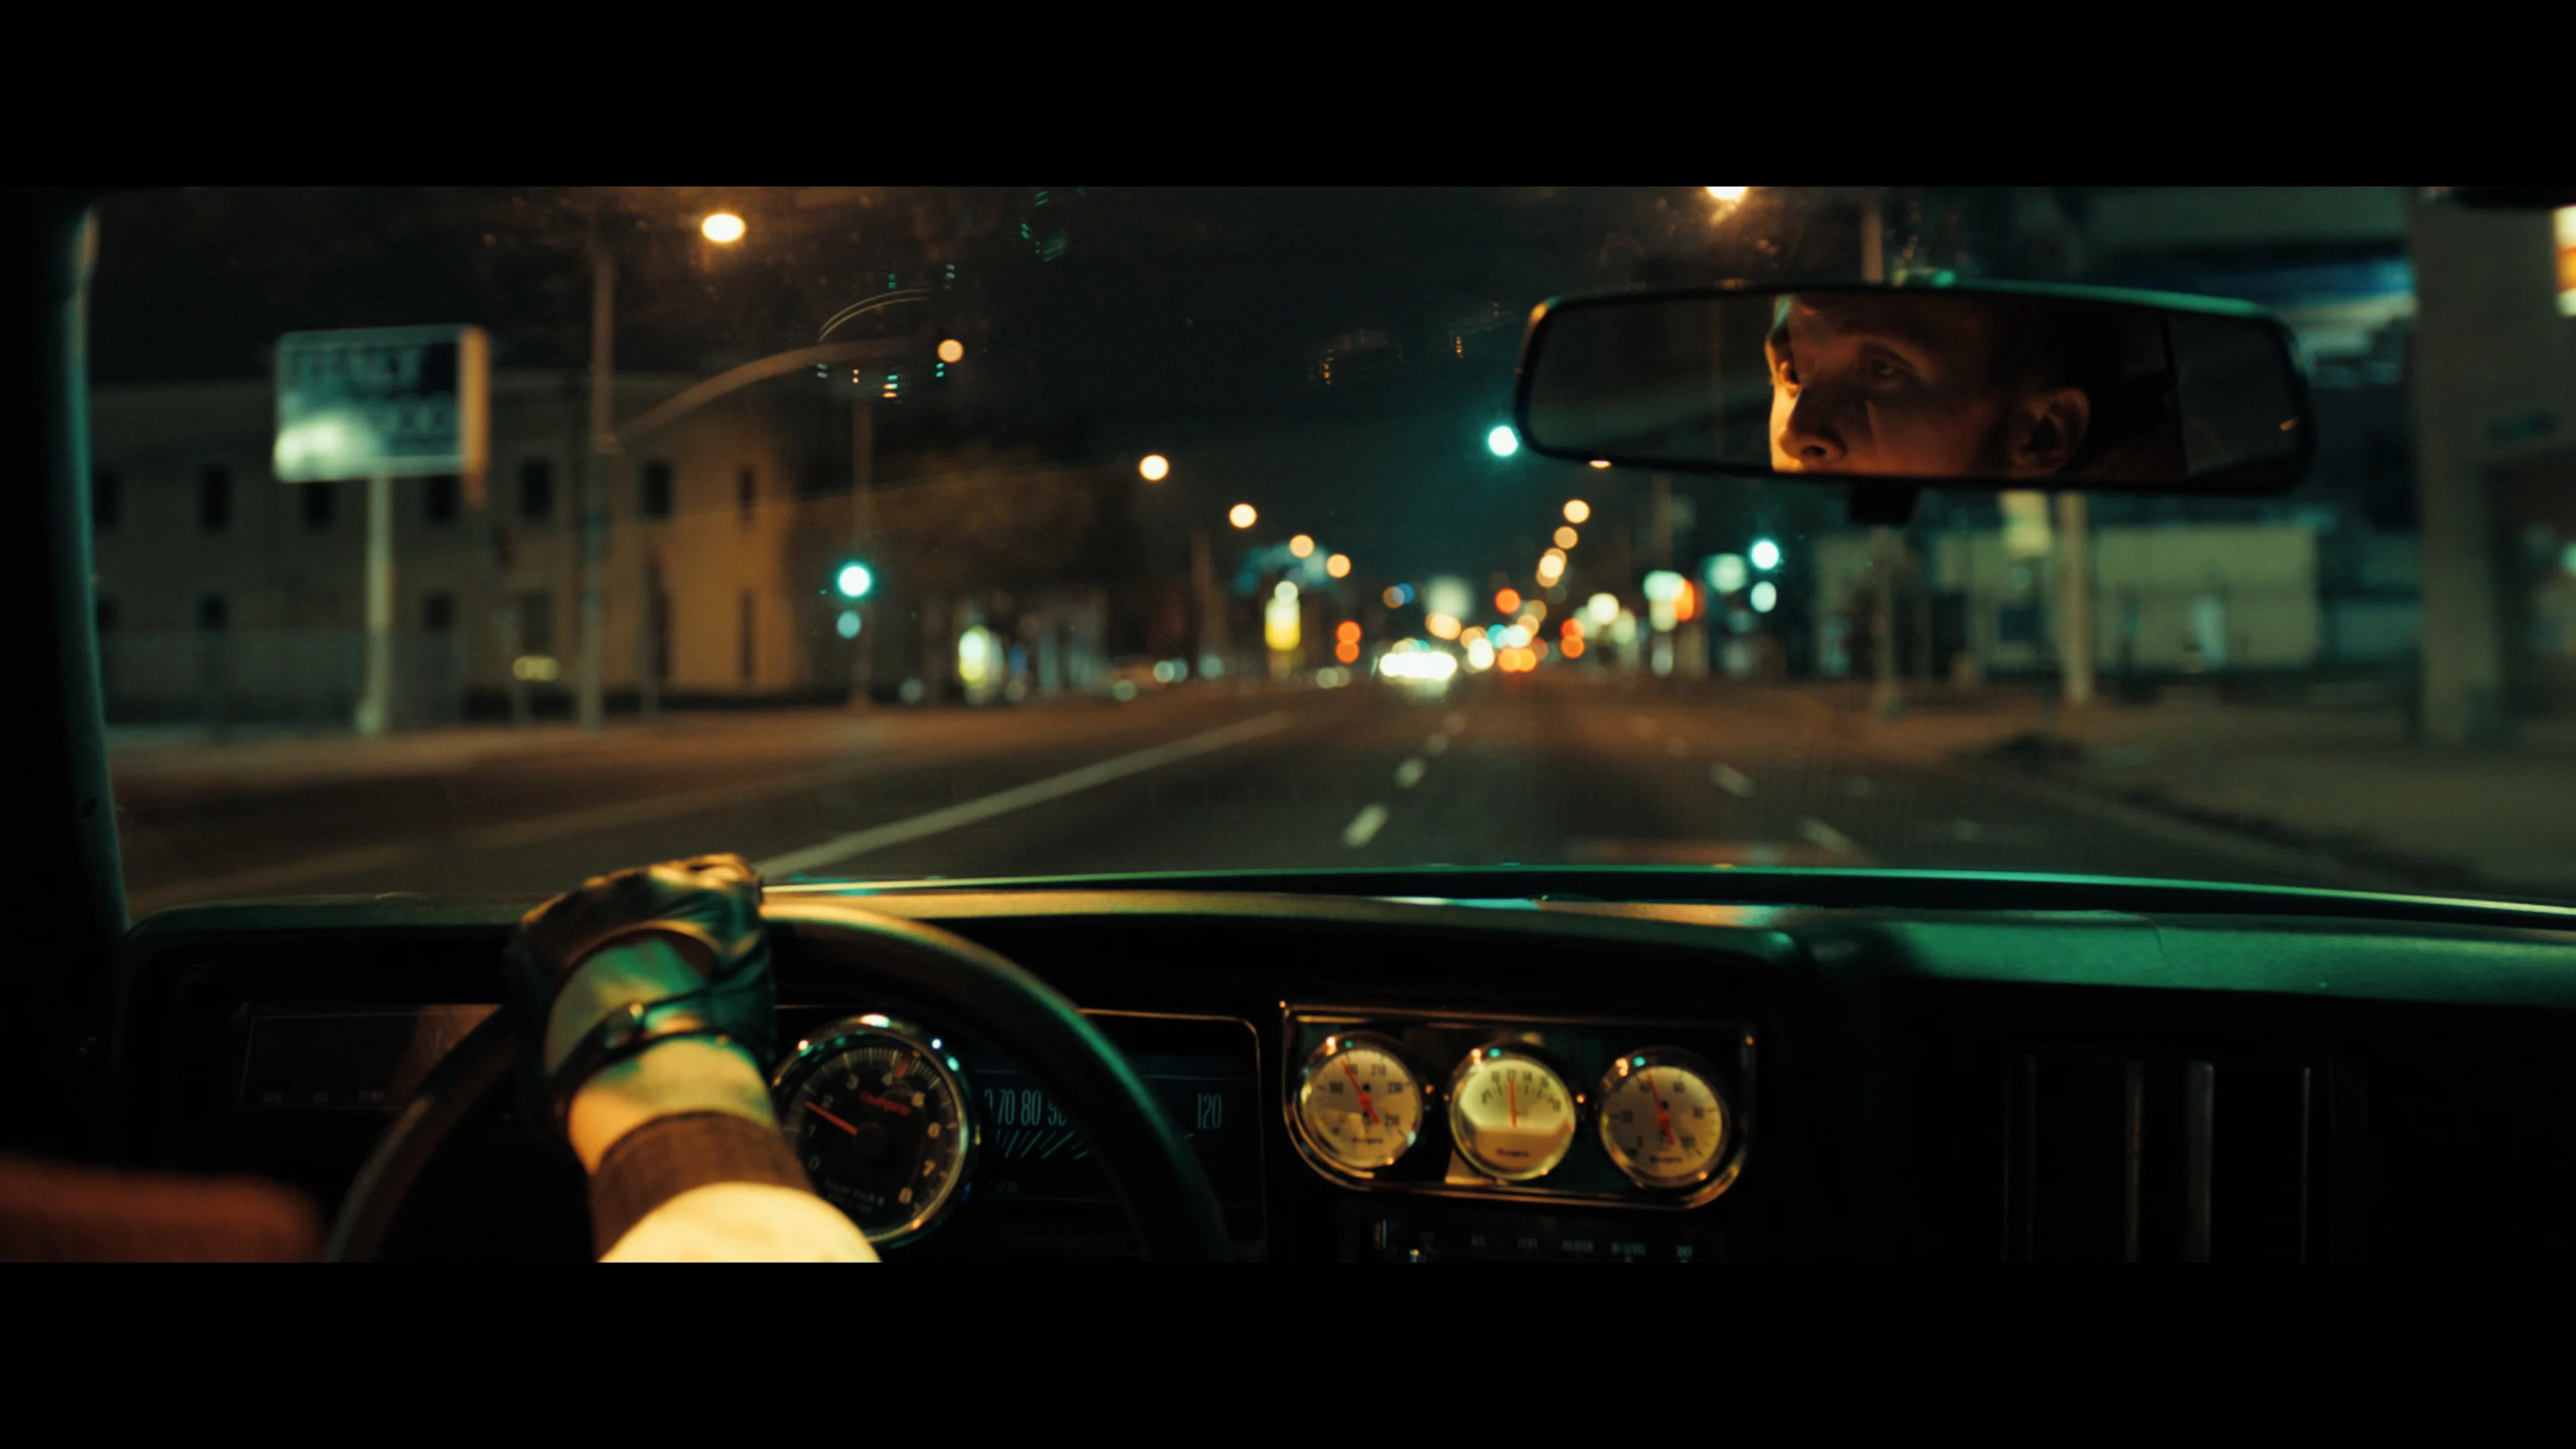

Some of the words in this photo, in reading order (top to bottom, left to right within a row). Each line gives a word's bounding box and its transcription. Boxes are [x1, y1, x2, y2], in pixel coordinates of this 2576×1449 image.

[846, 1074, 860, 1090] 3
[821, 1093, 835, 1110] 2
[998, 1089, 1016, 1126] 70
[1020, 1089, 1042, 1126] 80
[1197, 1093, 1222, 1130] 120
[927, 1122, 941, 1139] 6
[808, 1156, 821, 1172] 0
[922, 1159, 936, 1177] 7
